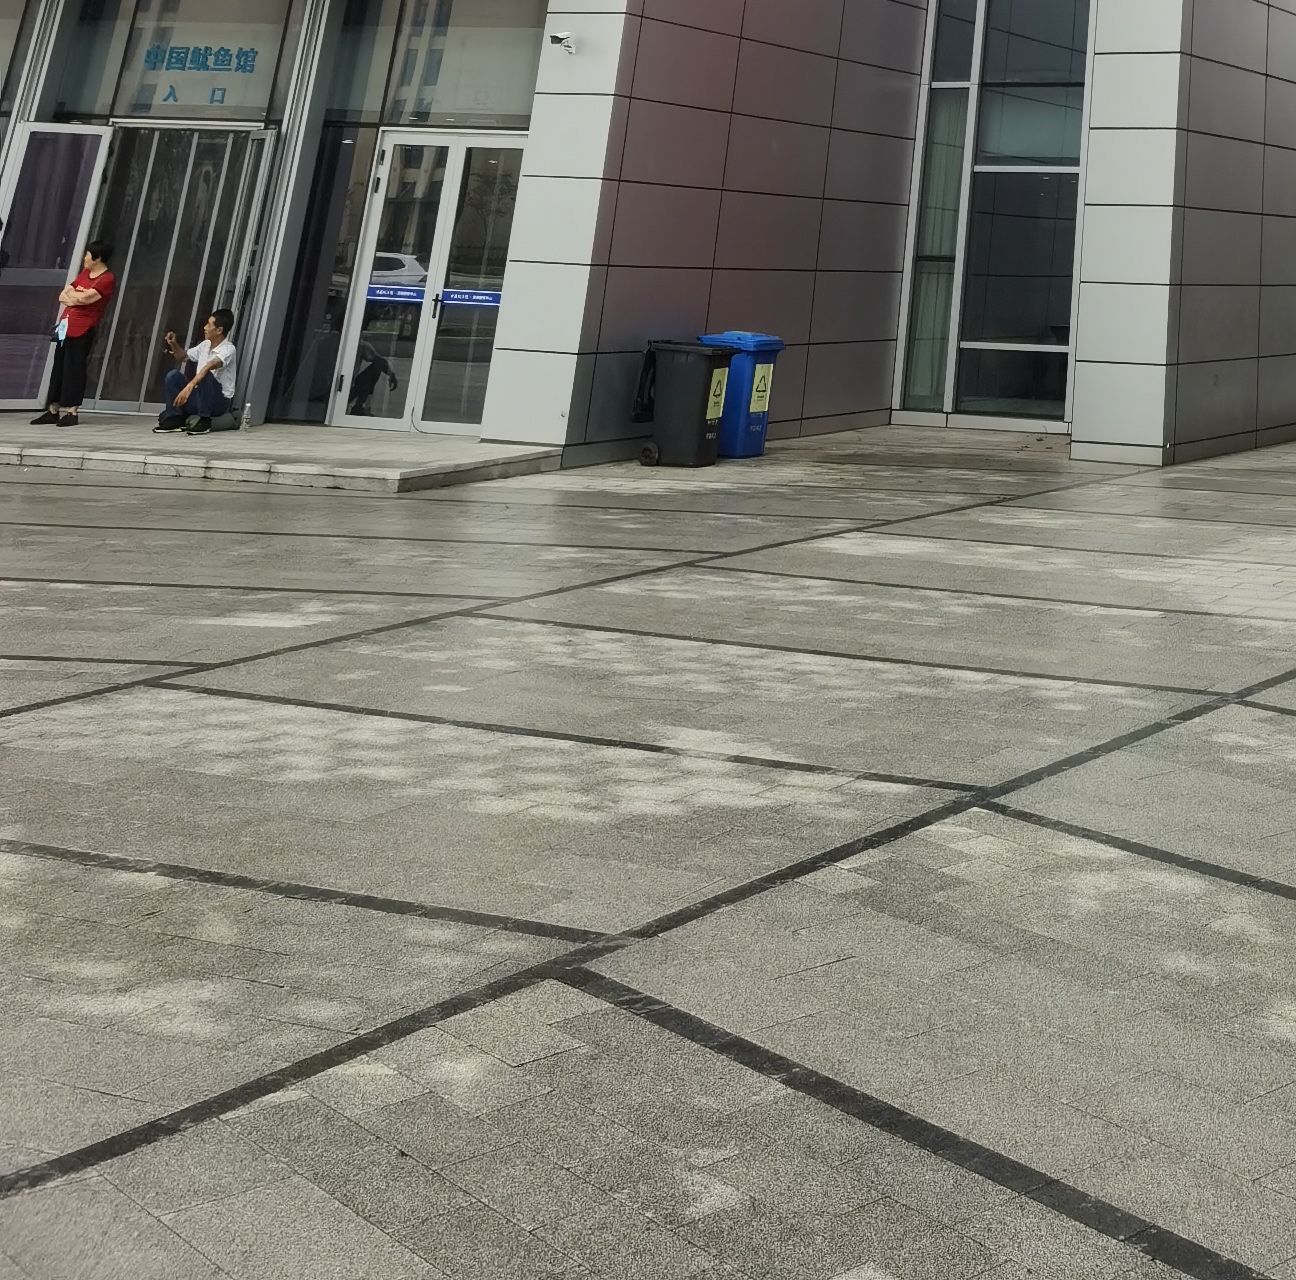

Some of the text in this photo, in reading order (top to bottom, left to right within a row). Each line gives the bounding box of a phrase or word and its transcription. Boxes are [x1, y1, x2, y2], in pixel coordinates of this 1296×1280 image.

[144, 44, 259, 74] 中国鱿鱼馆
